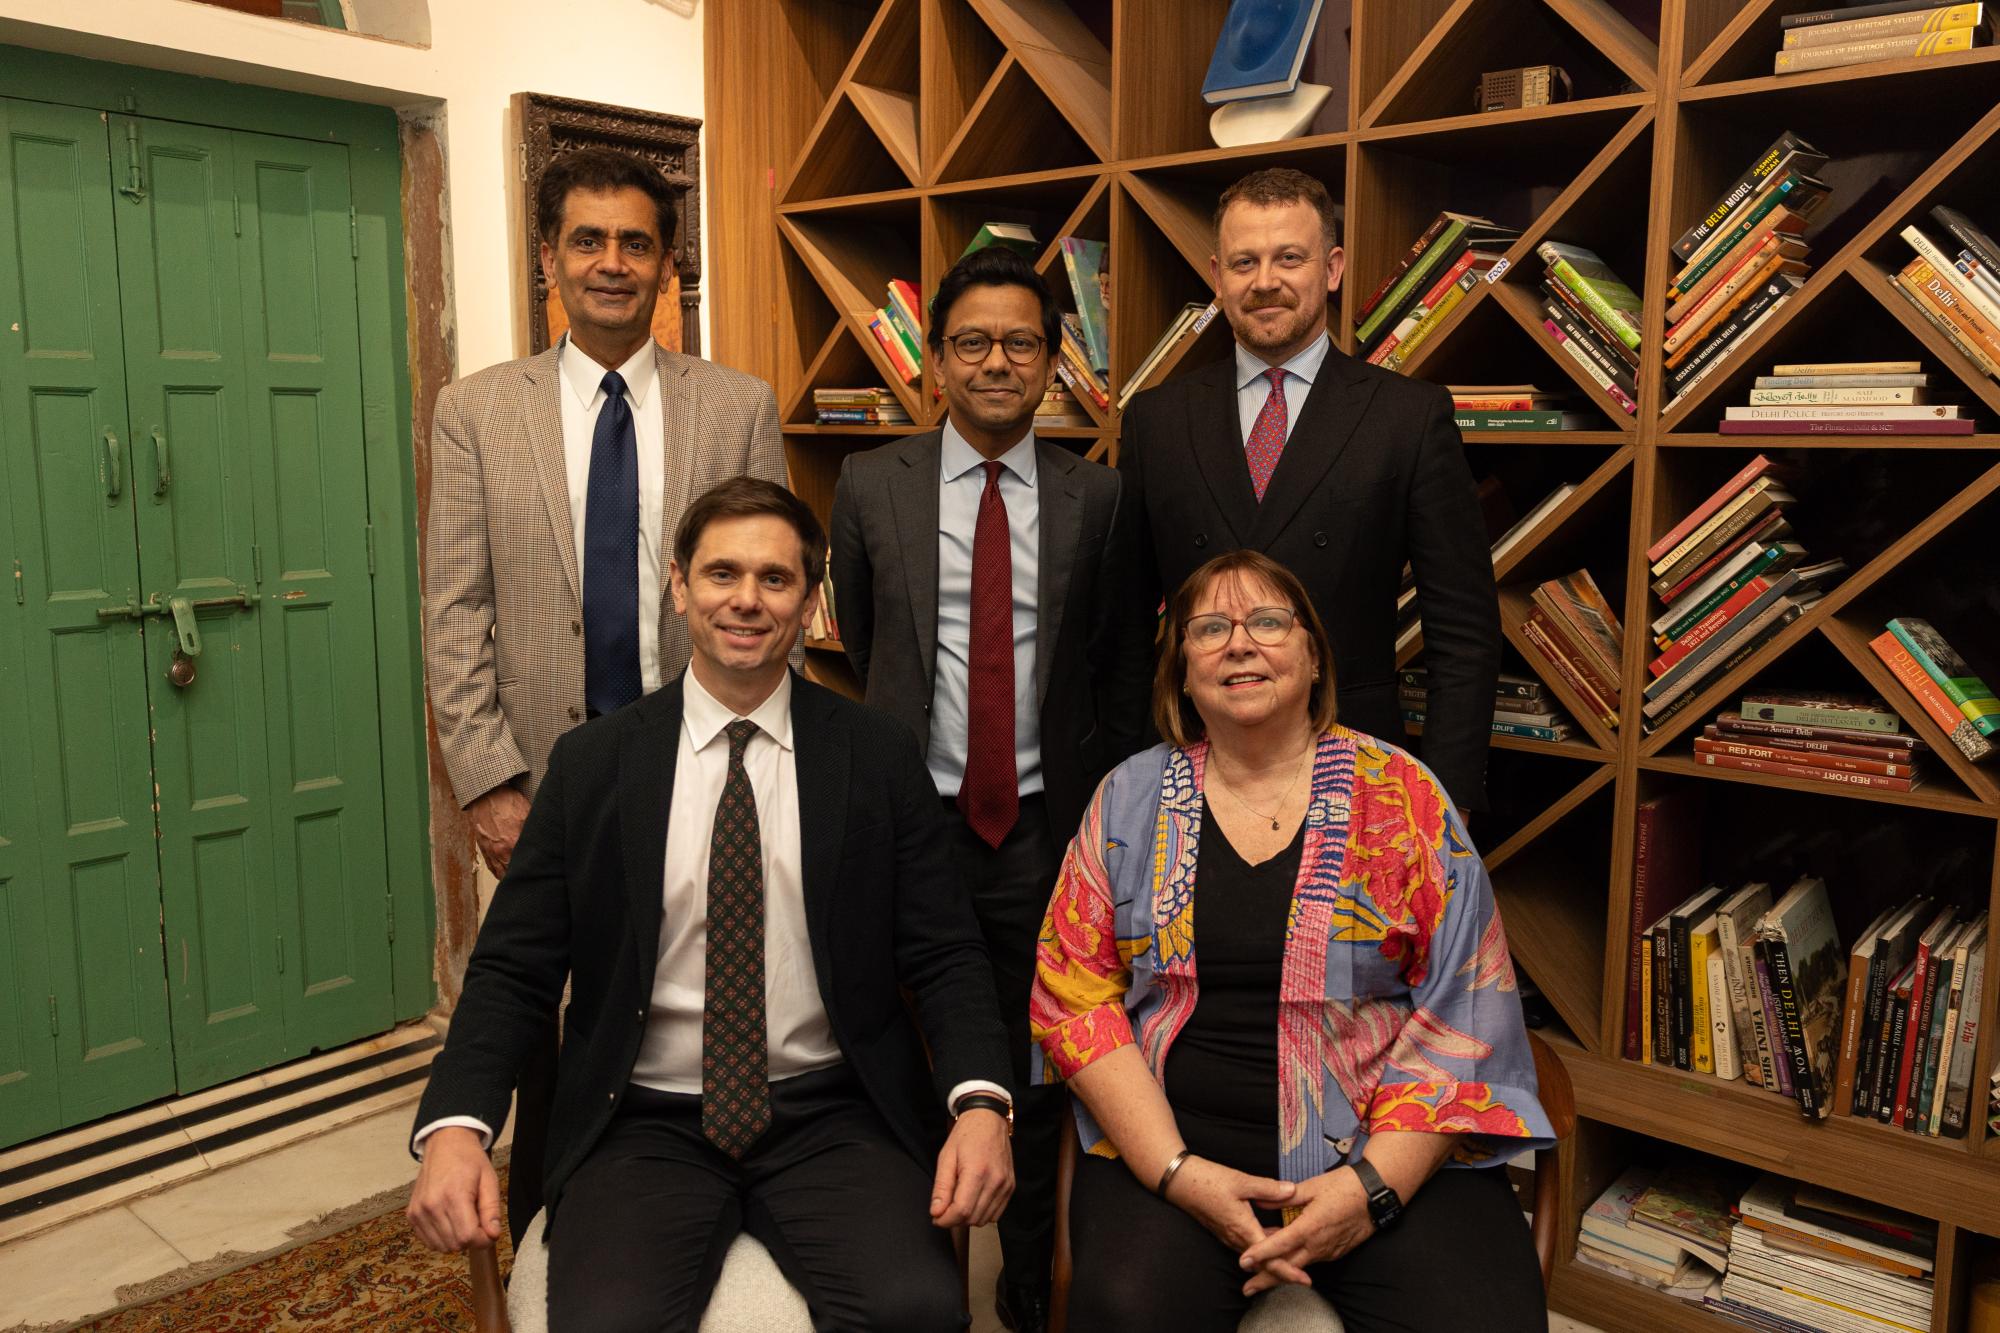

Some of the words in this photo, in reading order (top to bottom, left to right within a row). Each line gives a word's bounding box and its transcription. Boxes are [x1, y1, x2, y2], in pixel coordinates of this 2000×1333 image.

[1807, 26, 1839, 37] JOURNAL
[1853, 19, 1890, 30] HERITAGE
[1893, 14, 1925, 24] STUDIES
[1800, 49, 1833, 59] JOURNAL
[1846, 42, 1883, 53] HERITAGE
[1886, 38, 1918, 47] STUDIES
[1750, 148, 1779, 177] JASMINE
[1760, 157, 1780, 177] SHAH
[1692, 223, 1710, 240] THE
[1704, 203, 1729, 227] DELHI
[1724, 180, 1753, 208] MODEL
[1487, 259, 1509, 280] FOOD
[1926, 276, 1958, 308] Delhi
[1953, 303, 1964, 314] Past
[1961, 311, 1970, 320] and
[1194, 306, 1216, 331] HAVELI
[1938, 312, 1952, 326] DELHI
[1563, 341, 1590, 368] SMOOTHIES
[1674, 362, 1695, 381] ESSAYS
[1693, 357, 1701, 365] IN
[1698, 336, 1723, 360] MEDIEVAL
[1720, 323, 1737, 338] DELHI
[1751, 409, 1780, 418] DELHI
[1783, 409, 1817, 418] POLICE
[1662, 545, 1687, 567] DELHI
[1699, 629, 1709, 639] and
[1707, 614, 1728, 632] Beyond
[1680, 633, 1694, 646] Delhi
[1893, 648, 1929, 688] DELHI
[1928, 694, 1954, 724] MUKUNDAN
[1770, 726, 1794, 735] Ancient
[1796, 728, 1813, 737] Delhi
[1796, 715, 1816, 724] DELHI
[1816, 716, 1863, 728] SULTANATE
[1728, 746, 1747, 756] RED
[1749, 748, 1773, 758] FORT
[1806, 742, 1828, 750] DELHI
[1822, 772, 1848, 782] FORT
[1850, 776, 1870, 784] RED
[1743, 954, 1752, 974] DHAR
[1774, 951, 1789, 985] THEN
[1877, 959, 1887, 987] DIALECTS
[1953, 962, 1964, 985] DELHI
[1730, 976, 1745, 1003] INDIA
[1748, 975, 1757, 998] SHEILA
[1656, 995, 1664, 1015] CITY
[1772, 992, 1783, 1017] USTAD
[1781, 988, 1800, 1039] DELHI
[1872, 997, 1882, 1021] SILENCE
[1923, 996, 1931, 1010] OLD
[1751, 1009, 1768, 1053] INDIA
[1893, 1007, 1904, 1045] MEHRAULI
[1920, 1011, 1929, 1031] DELHI
[1960, 1019, 1976, 1044] Delhi
[1760, 1055, 1775, 1088] THIS
